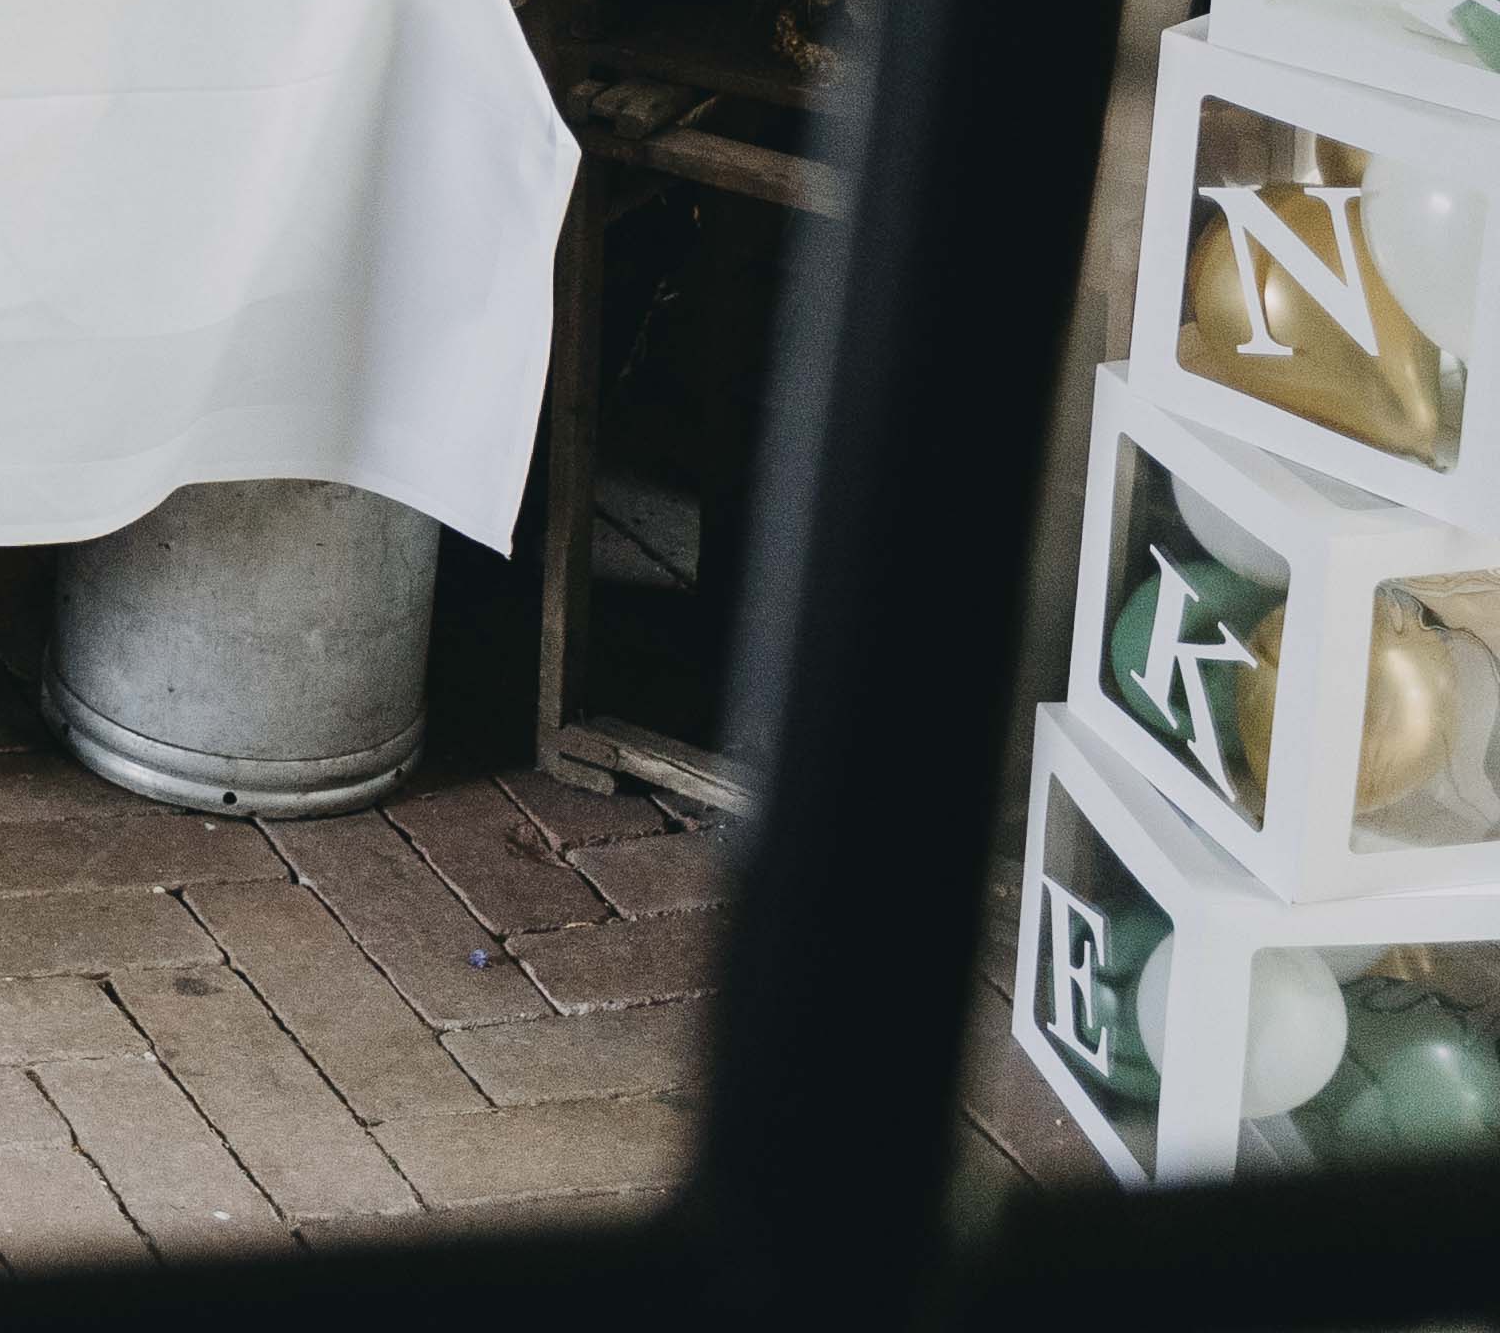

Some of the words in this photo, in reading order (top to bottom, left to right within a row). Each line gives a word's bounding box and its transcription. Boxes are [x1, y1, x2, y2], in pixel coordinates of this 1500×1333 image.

[1198, 186, 1381, 357] N
[1130, 543, 1259, 804] K
[1042, 873, 1111, 1080] E
